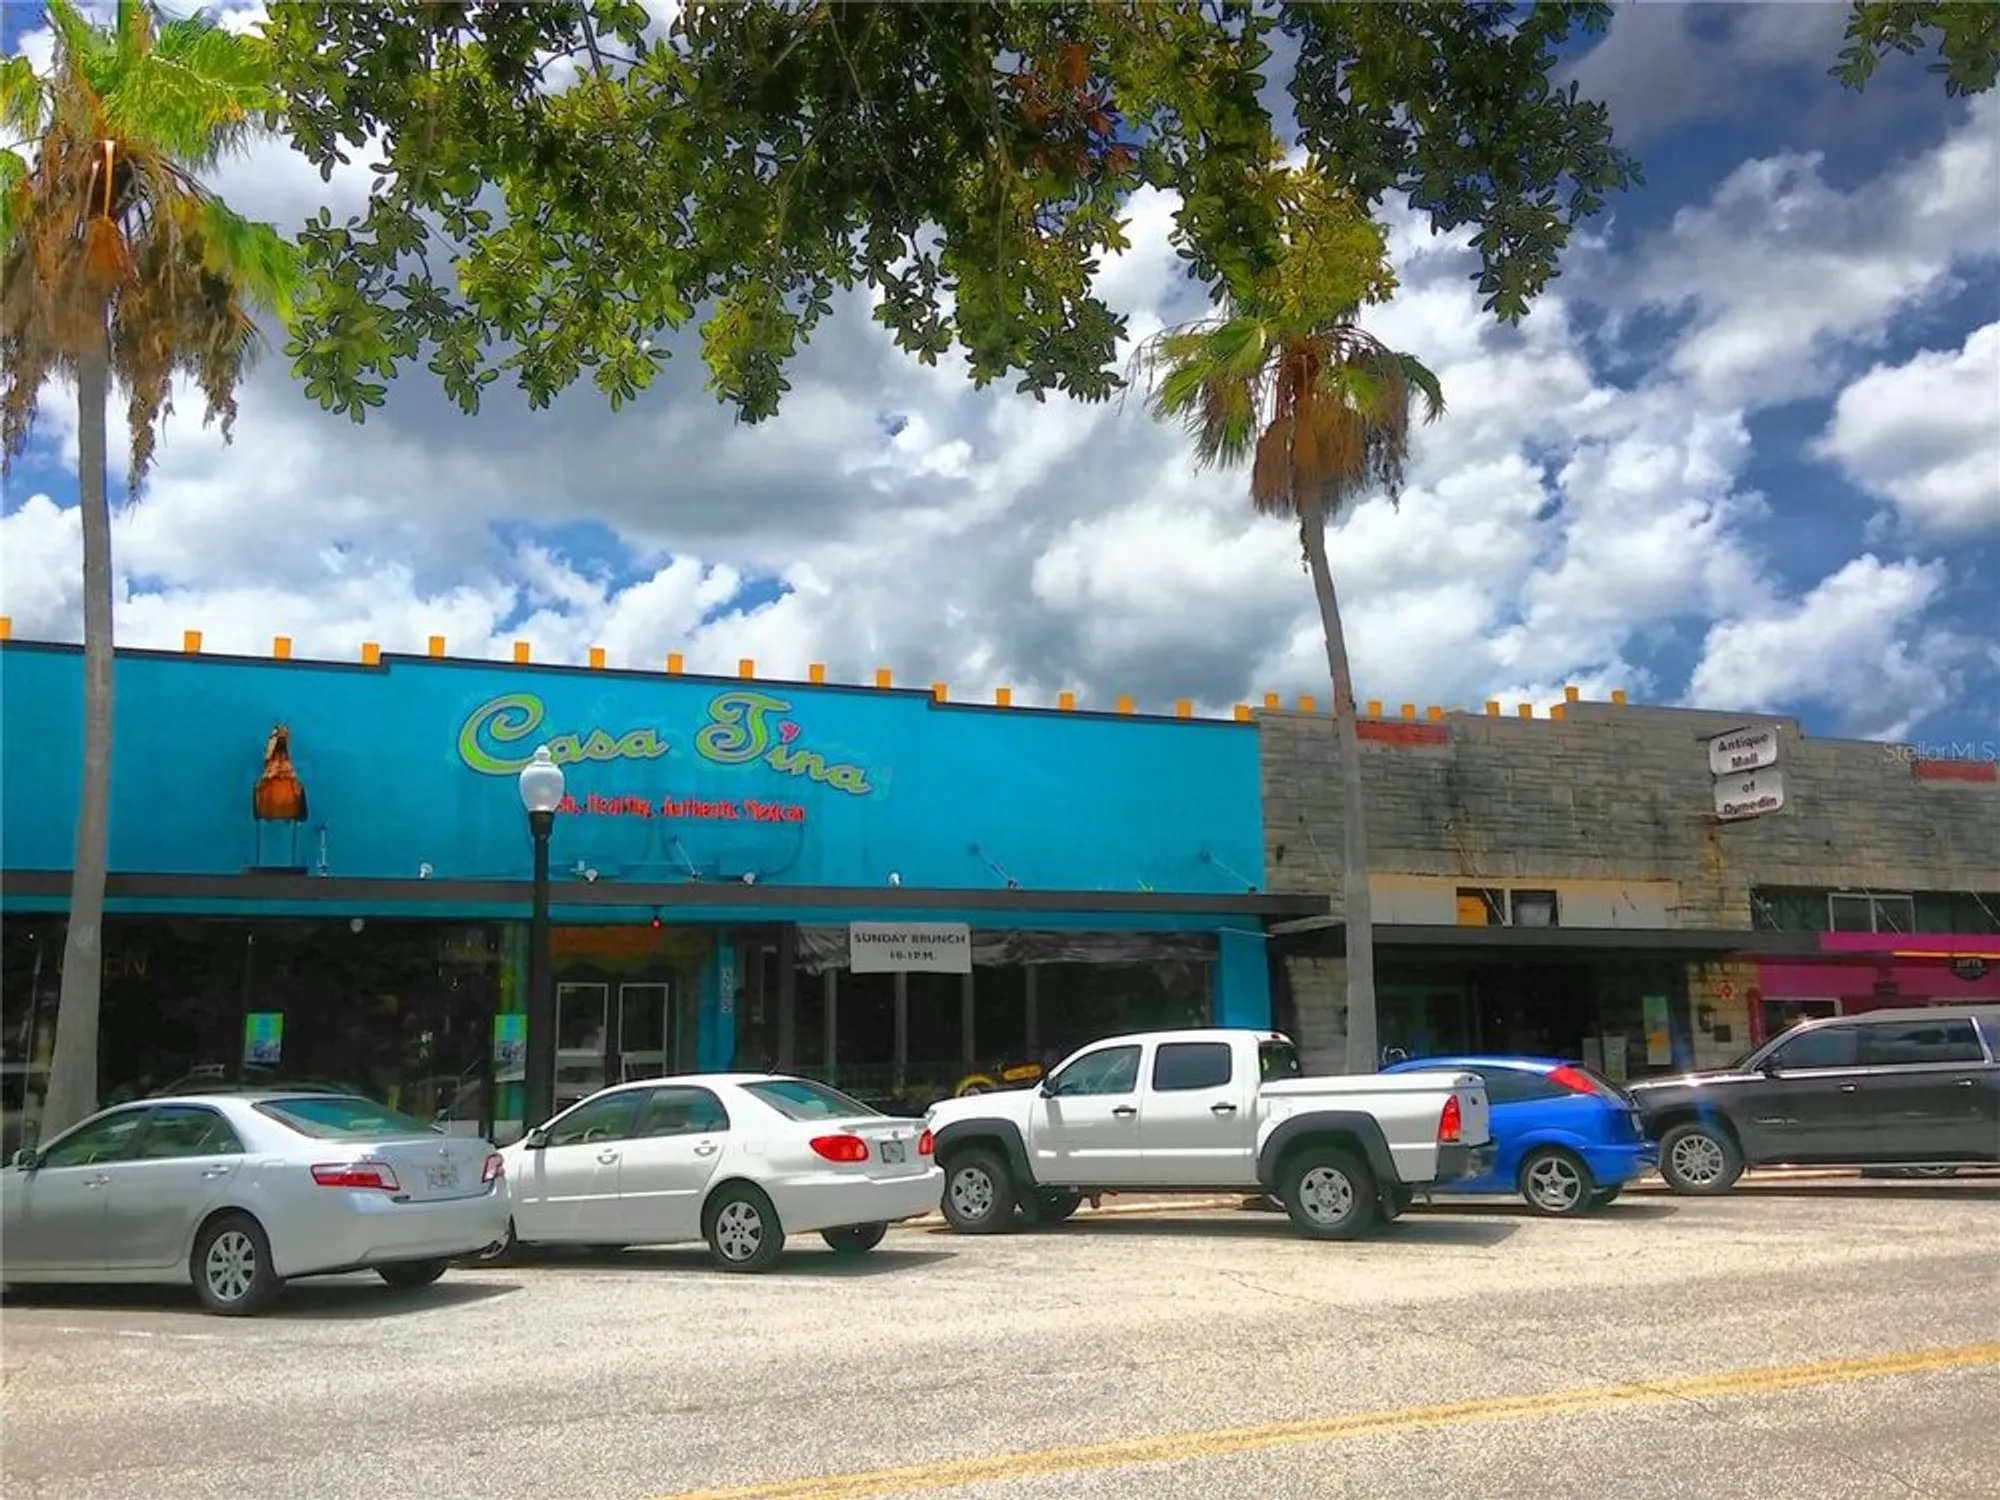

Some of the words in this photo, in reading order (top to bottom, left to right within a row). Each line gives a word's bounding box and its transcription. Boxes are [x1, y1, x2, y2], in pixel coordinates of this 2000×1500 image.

[458, 691, 671, 777] Casa
[694, 690, 874, 796] Tina
[1718, 733, 1769, 753] Antique
[1731, 752, 1758, 768] Mall
[1742, 779, 1755, 793] of
[743, 798, 804, 822] Mexican
[854, 932, 908, 944] SUNDAY
[911, 932, 966, 945] BRUNCH
